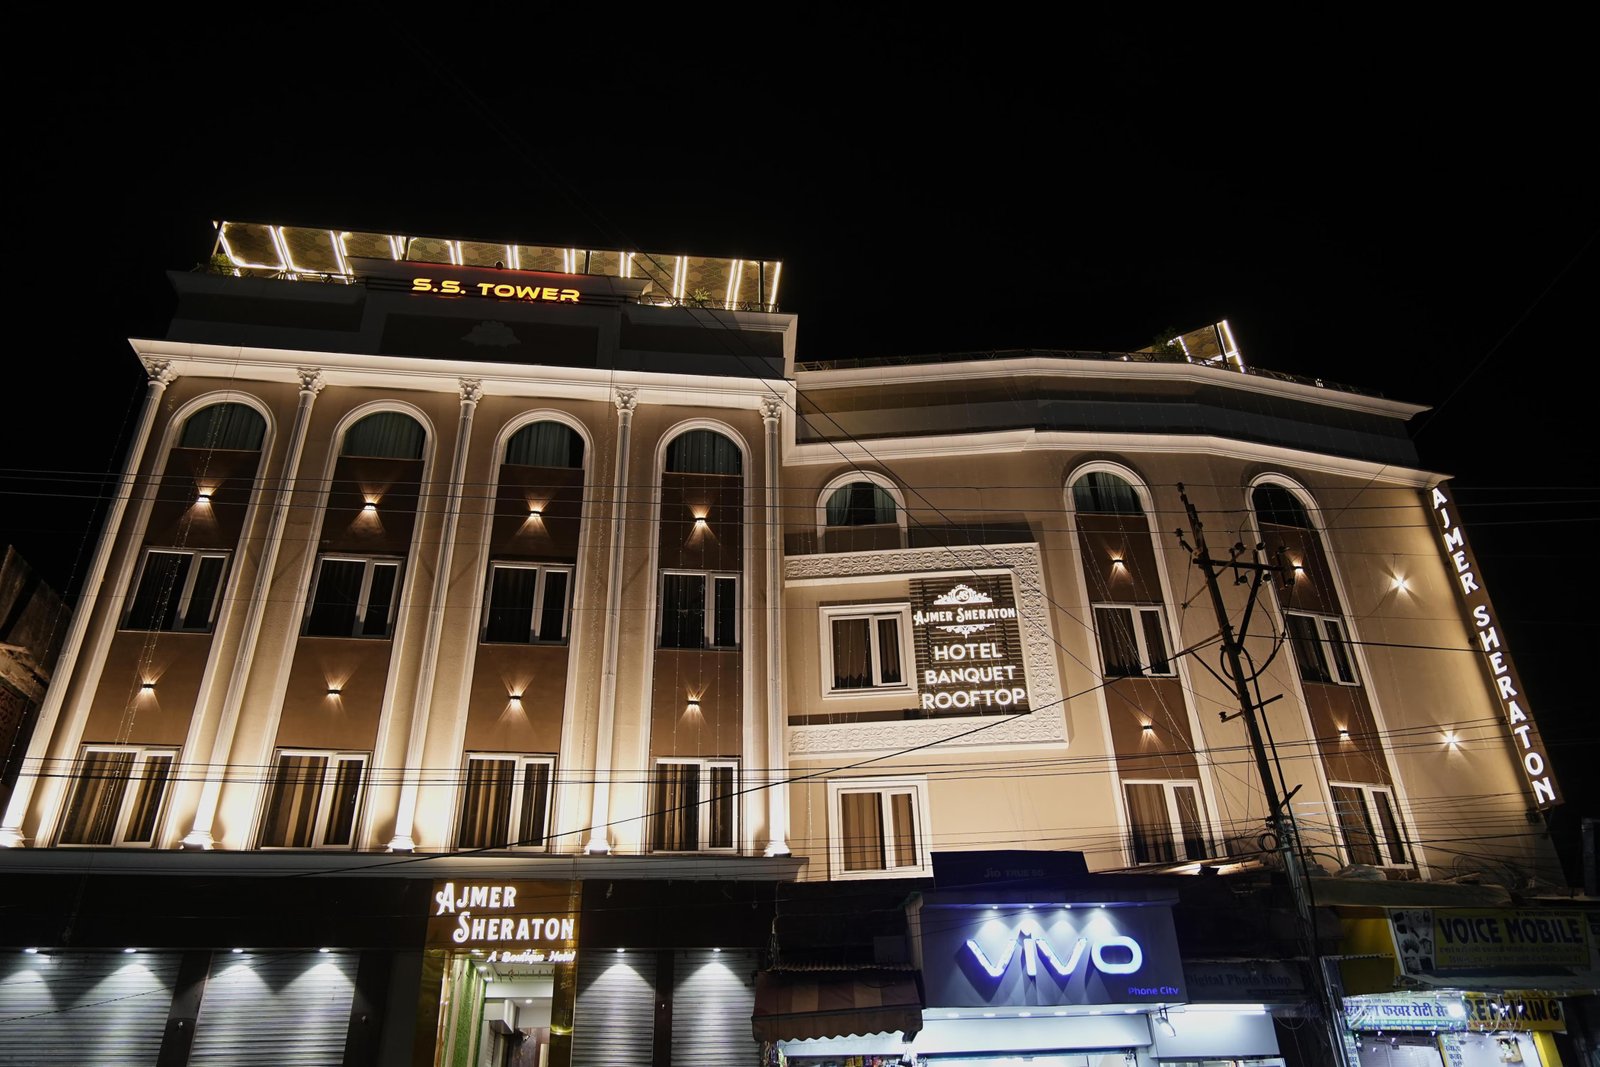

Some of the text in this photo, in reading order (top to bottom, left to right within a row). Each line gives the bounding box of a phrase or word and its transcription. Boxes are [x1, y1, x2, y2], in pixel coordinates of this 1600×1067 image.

[412, 277, 580, 302] S.S. TOWER
[913, 607, 1016, 626] AJMER SHERATON
[934, 642, 1003, 661] HOTEL
[1431, 487, 1556, 805] AJMER SHERATON
[925, 665, 1017, 685] BANQUET
[922, 688, 1026, 710] ROOFTOP
[435, 882, 517, 916] AJMER
[452, 911, 575, 944] SHERATON
[1438, 917, 1502, 944] VOICE
[1504, 917, 1584, 944] MOBILE
[486, 950, 497, 963] A
[1127, 985, 1180, 998] Phone City
[1463, 998, 1560, 1022] REPAIRING
